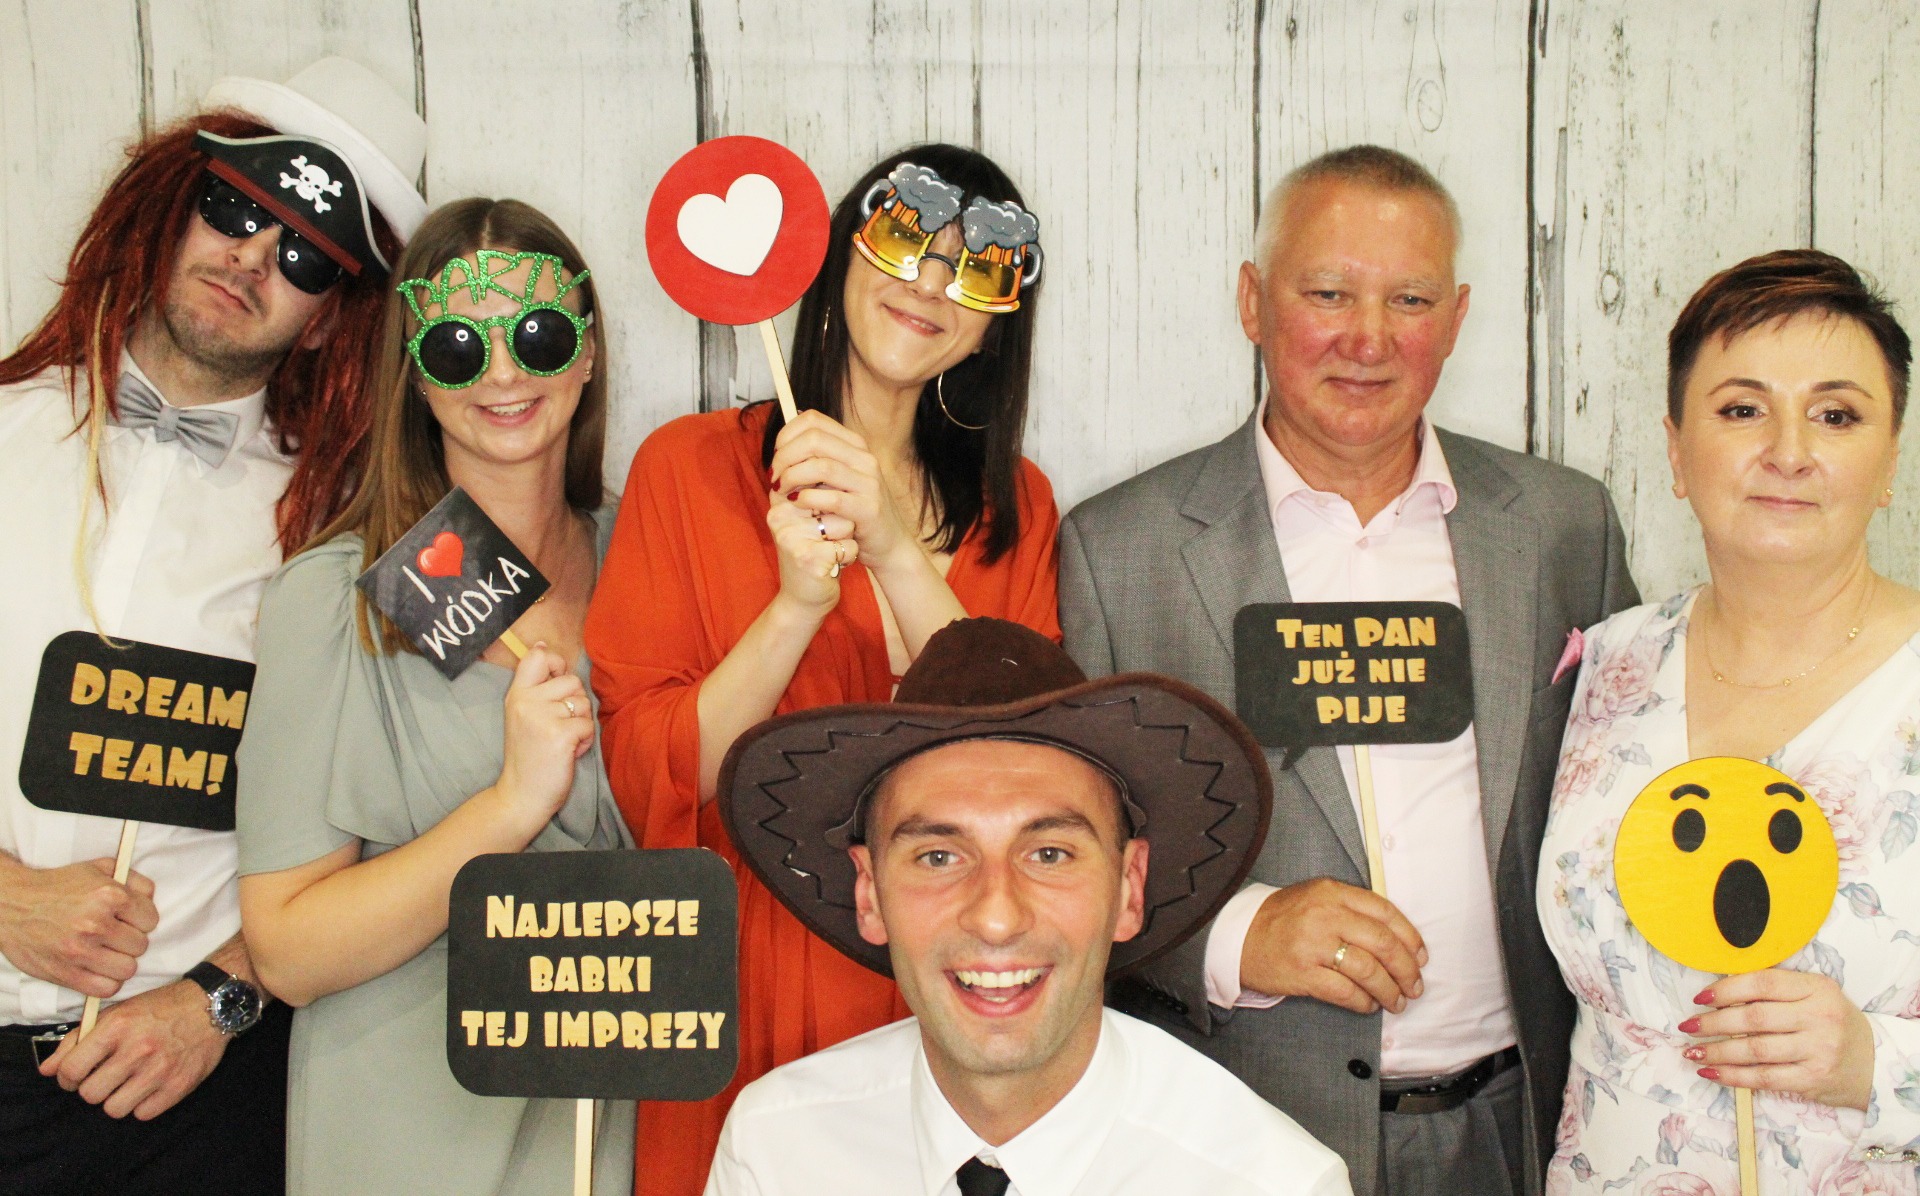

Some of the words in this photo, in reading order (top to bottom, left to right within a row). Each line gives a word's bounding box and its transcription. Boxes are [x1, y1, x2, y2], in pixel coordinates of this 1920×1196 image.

[396, 249, 591, 325] PARTY
[422, 556, 530, 660] WÓDKA
[1354, 617, 1437, 647] PAN
[1292, 651, 1355, 685] JUŻ
[1368, 658, 1426, 683] NIE
[70, 662, 248, 730] DREAM
[1316, 695, 1406, 724] PIJE
[69, 731, 228, 796] TEAM!
[530, 955, 652, 992] BABKI
[461, 1010, 529, 1047] TEJ
[544, 1010, 726, 1050] IMPREZY
